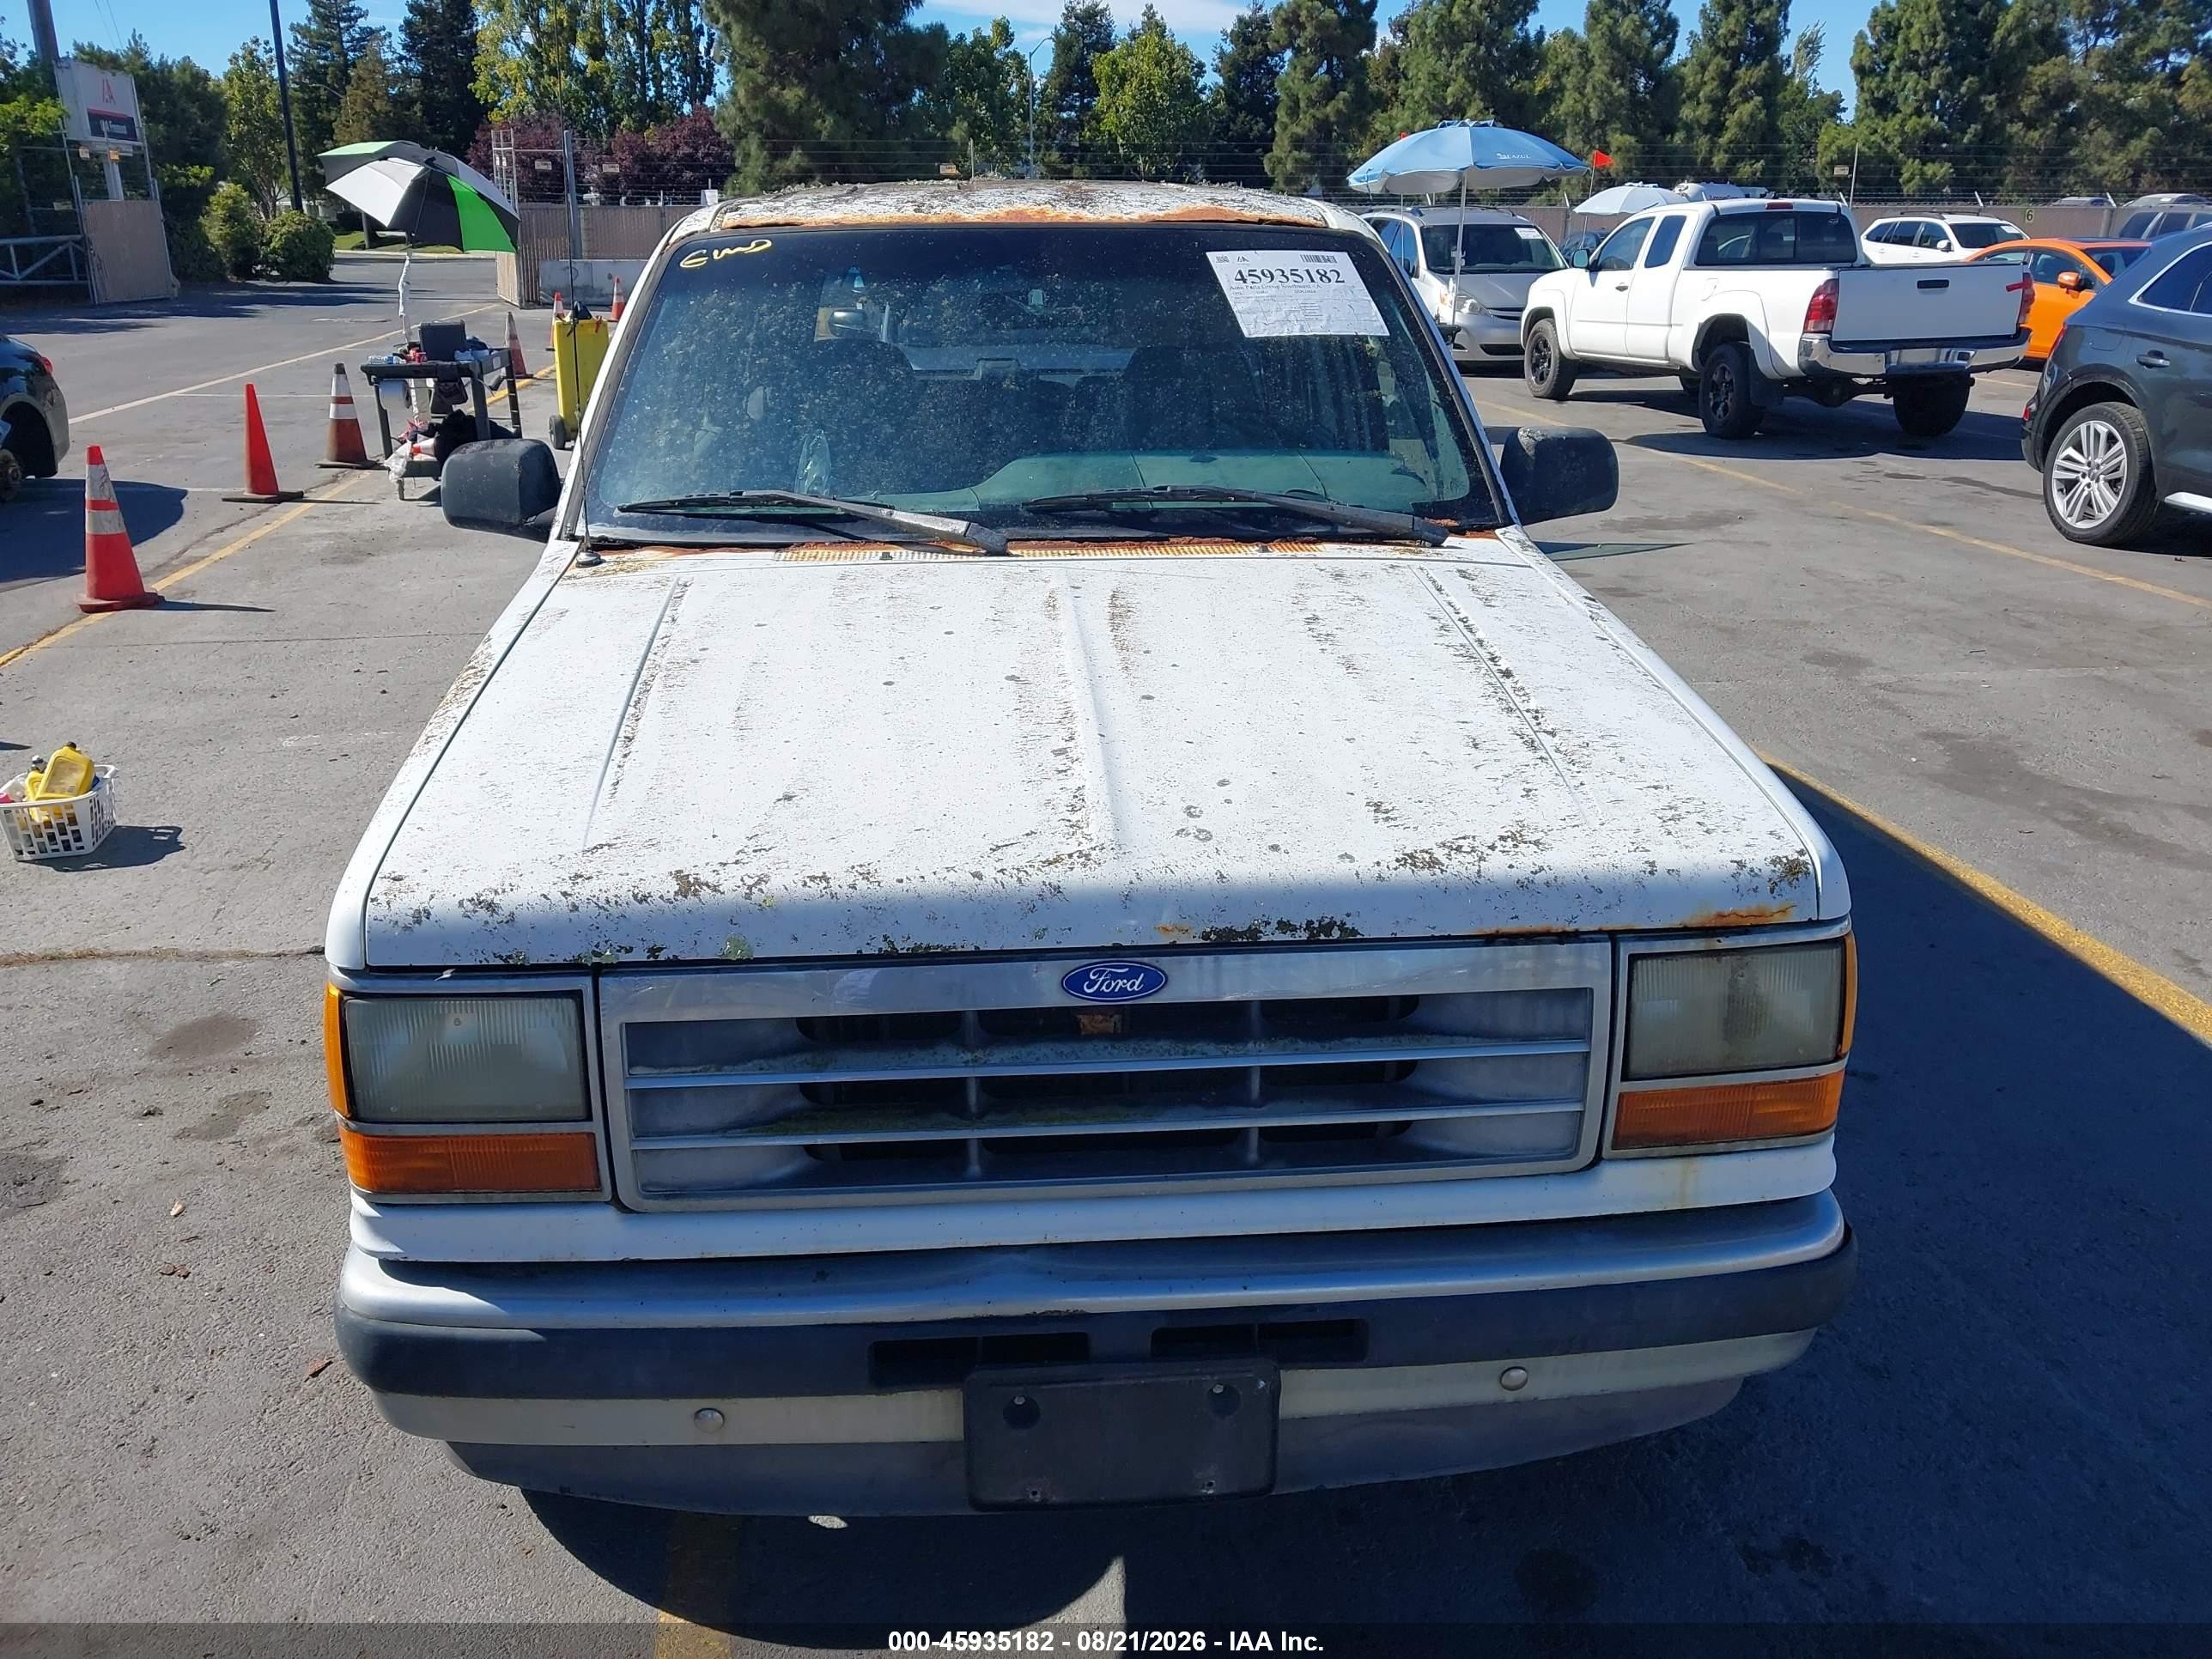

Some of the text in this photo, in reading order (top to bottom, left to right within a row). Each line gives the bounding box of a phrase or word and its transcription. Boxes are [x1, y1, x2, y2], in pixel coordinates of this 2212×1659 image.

[2027, 210, 2033, 222] 6
[1234, 268, 1346, 284] 45935182
[1083, 968, 1145, 994] Ford
